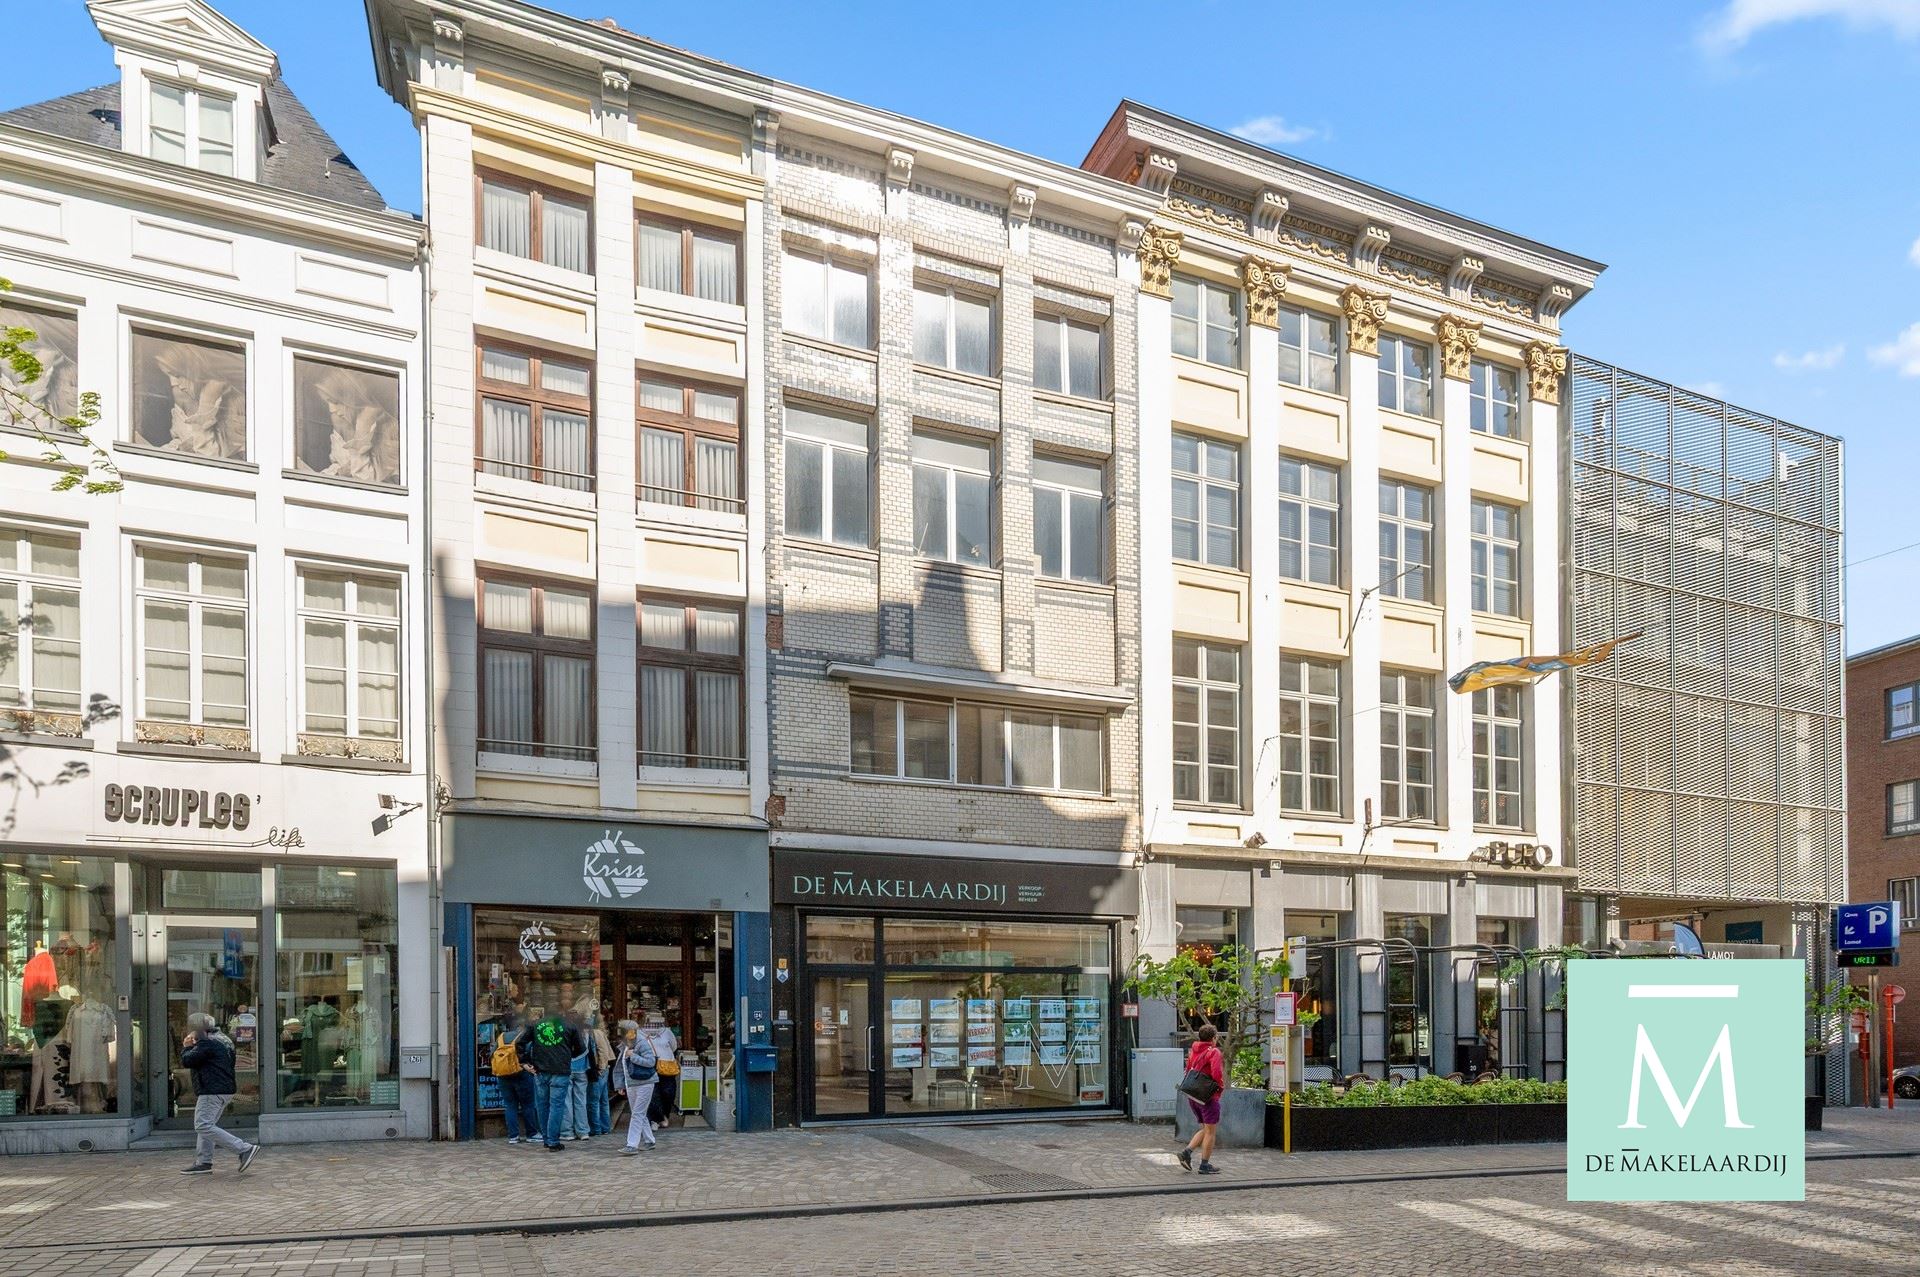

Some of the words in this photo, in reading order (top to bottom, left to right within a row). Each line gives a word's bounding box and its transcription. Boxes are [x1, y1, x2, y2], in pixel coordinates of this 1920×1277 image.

[268, 826, 305, 855] life
[584, 853, 645, 878] Kriss
[794, 876, 825, 895] DE
[833, 872, 1006, 904] MAKELAARDIJ
[1869, 911, 1887, 933] P
[520, 935, 556, 950] Kriss
